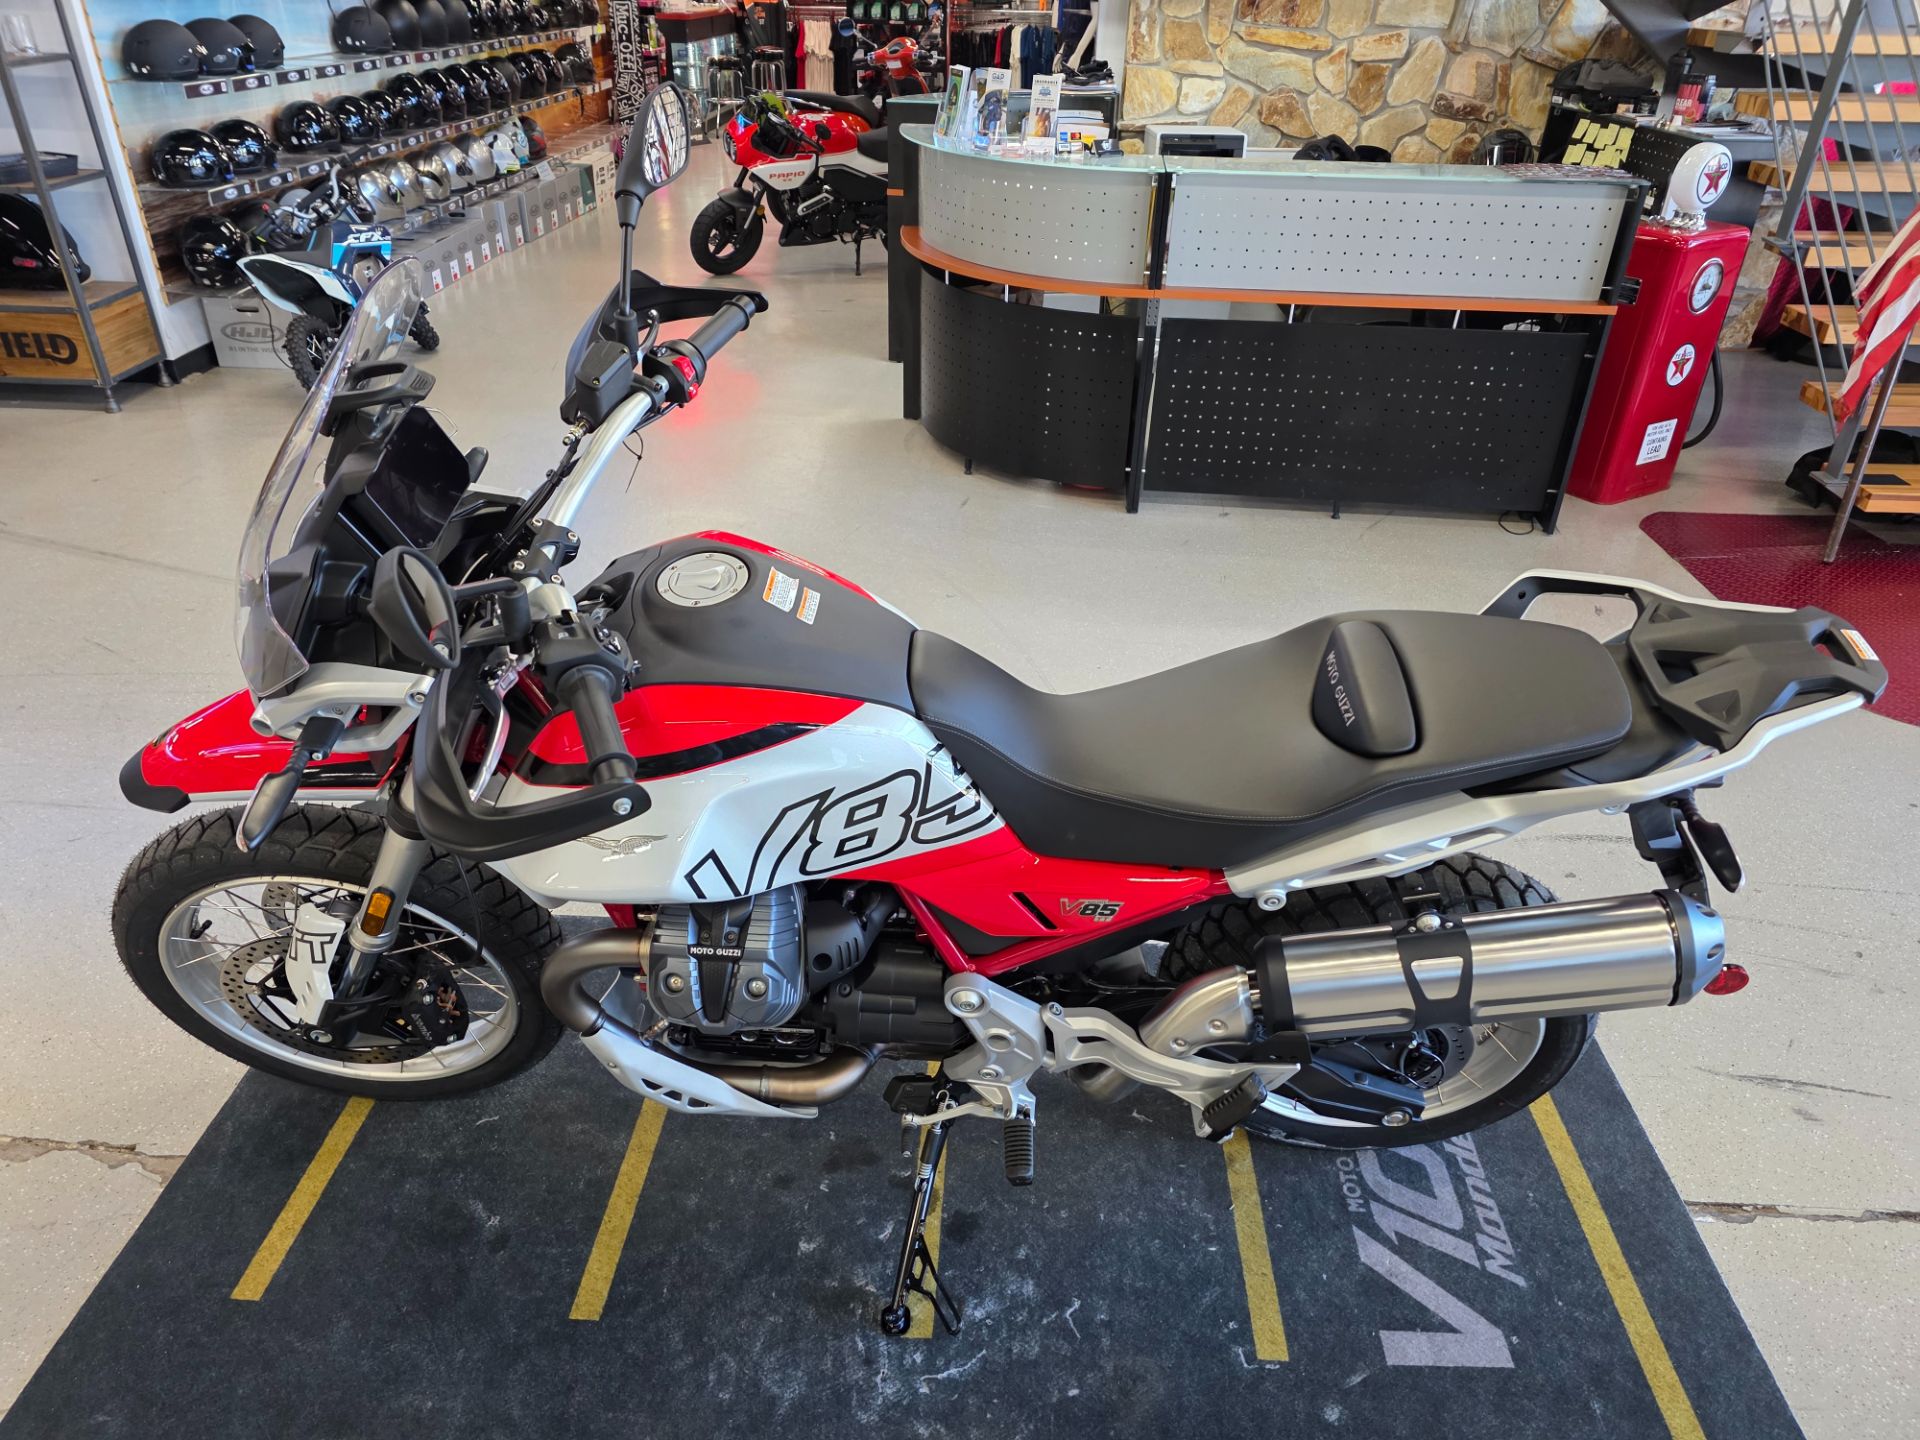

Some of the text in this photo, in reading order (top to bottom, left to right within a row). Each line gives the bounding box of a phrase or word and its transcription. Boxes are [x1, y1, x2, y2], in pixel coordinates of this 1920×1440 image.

[616, 4, 634, 71] Muc-Off
[769, 170, 805, 180] PAPIO
[1646, 435, 1668, 446] CONTAINS
[1646, 444, 1662, 455] LEAD
[1326, 650, 1356, 727] MOTO GUZZI
[1060, 898, 1124, 917] V85
[690, 947, 741, 957] MOTO GUZZI
[1336, 1156, 1367, 1213] MOTO
